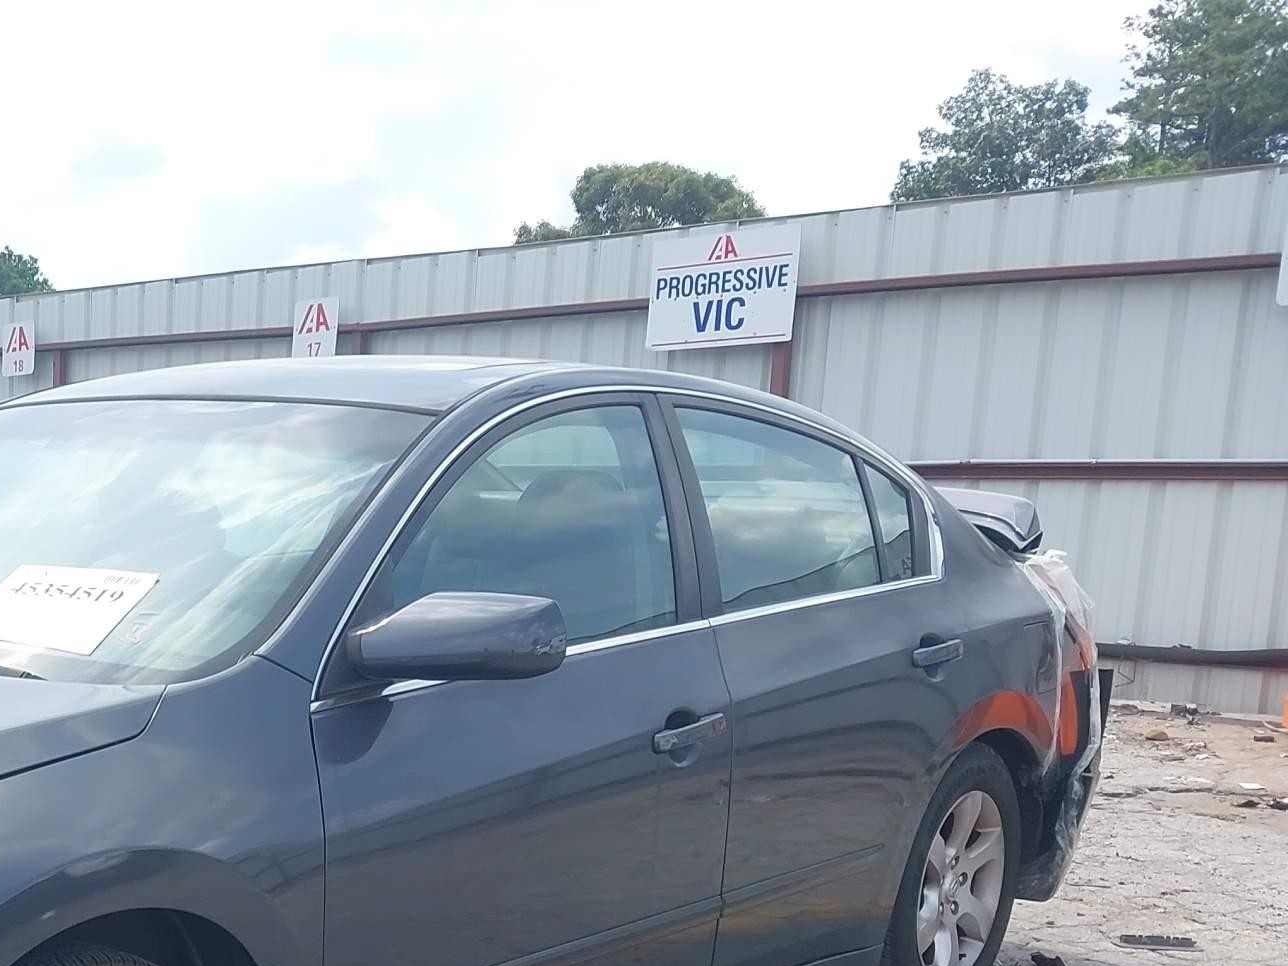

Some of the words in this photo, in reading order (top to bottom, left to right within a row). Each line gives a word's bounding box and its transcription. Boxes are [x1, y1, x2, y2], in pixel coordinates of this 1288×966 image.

[655, 263, 790, 300] PROGRESSIVE
[692, 296, 746, 333] VIC
[307, 341, 321, 358] 17
[14, 359, 24, 373] 18
[11, 581, 125, 602] 45354519
